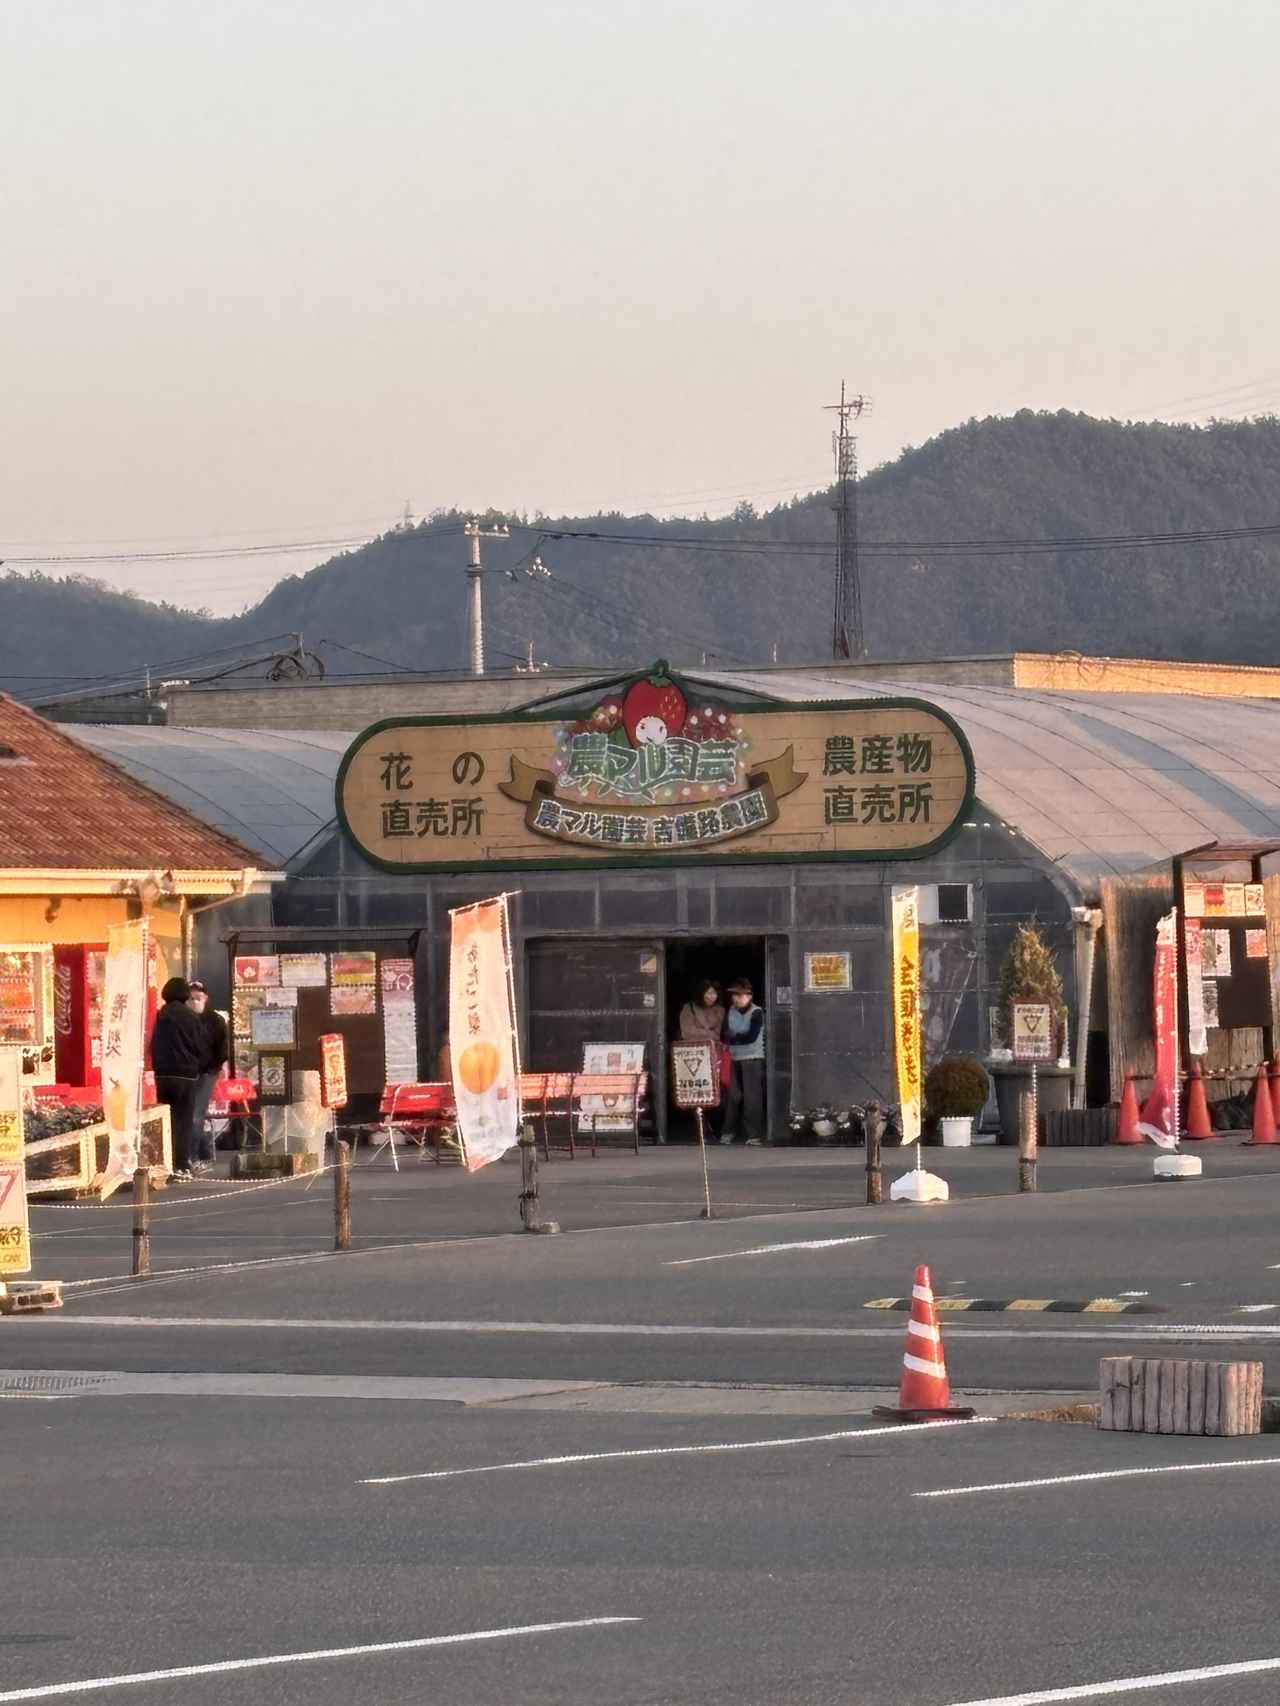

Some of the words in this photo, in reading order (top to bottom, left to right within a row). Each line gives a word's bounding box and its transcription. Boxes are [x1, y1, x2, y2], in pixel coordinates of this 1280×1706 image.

[379, 752, 485, 791] 花の
[823, 732, 933, 777] 農産物
[380, 797, 485, 839] 直売所
[823, 781, 934, 825] 直売所
